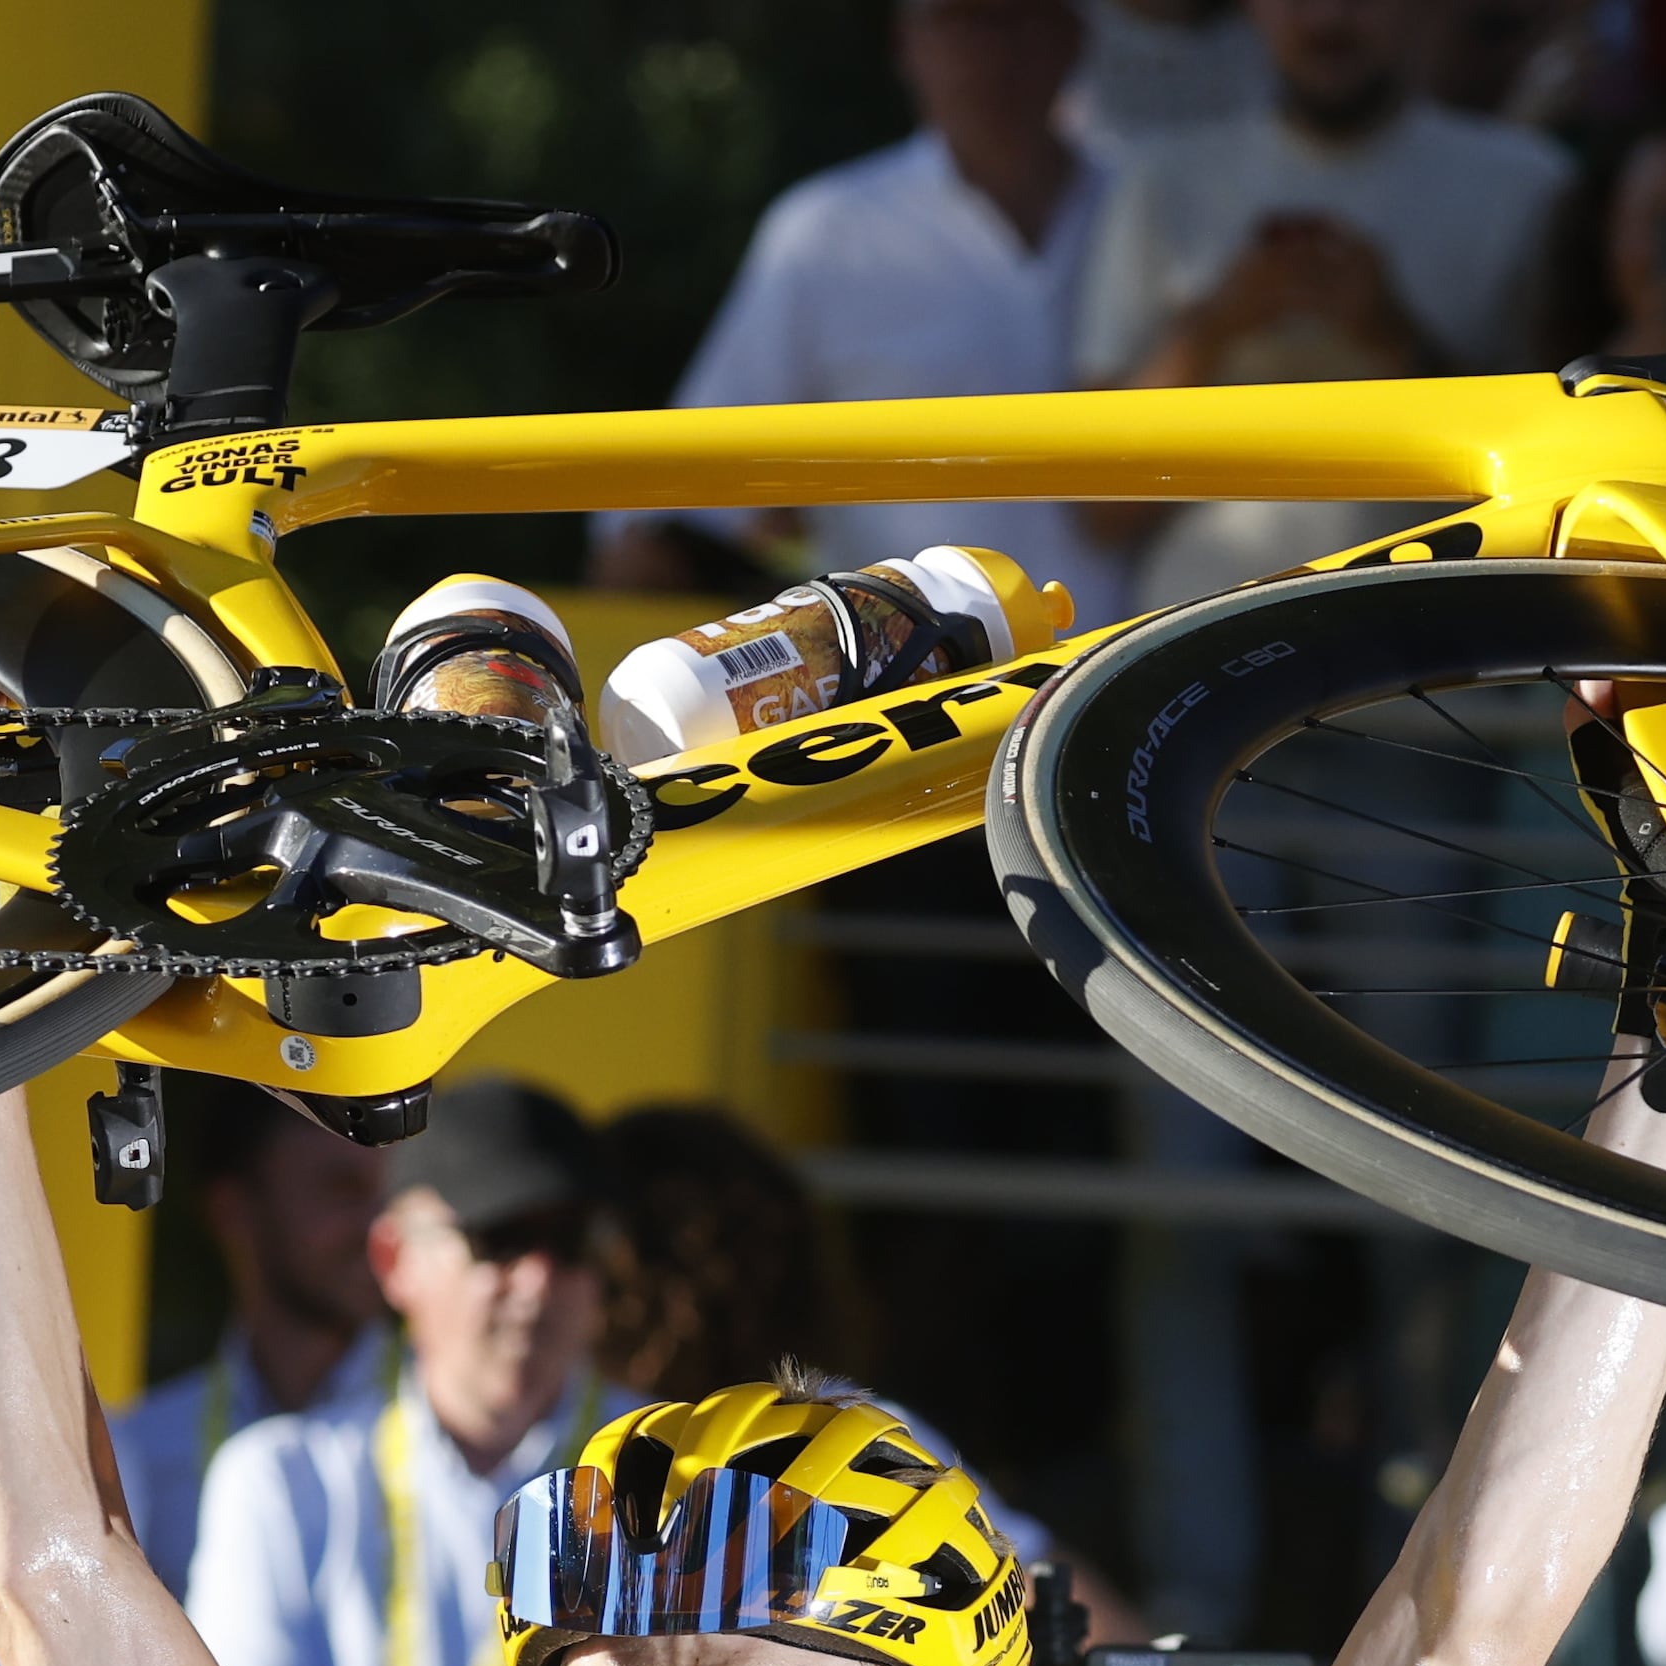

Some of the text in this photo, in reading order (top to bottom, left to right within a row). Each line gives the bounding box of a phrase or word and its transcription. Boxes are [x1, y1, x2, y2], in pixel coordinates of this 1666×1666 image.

[229, 429, 303, 443] FRANCE
[175, 439, 301, 468] JONAS
[180, 453, 293, 474] VINDER
[160, 466, 307, 493] GULT
[1221, 640, 1297, 678] C60
[1126, 681, 1211, 844] DURA-ACE
[137, 757, 239, 806] DURA-ACE
[331, 797, 484, 867] DURA-ACE
